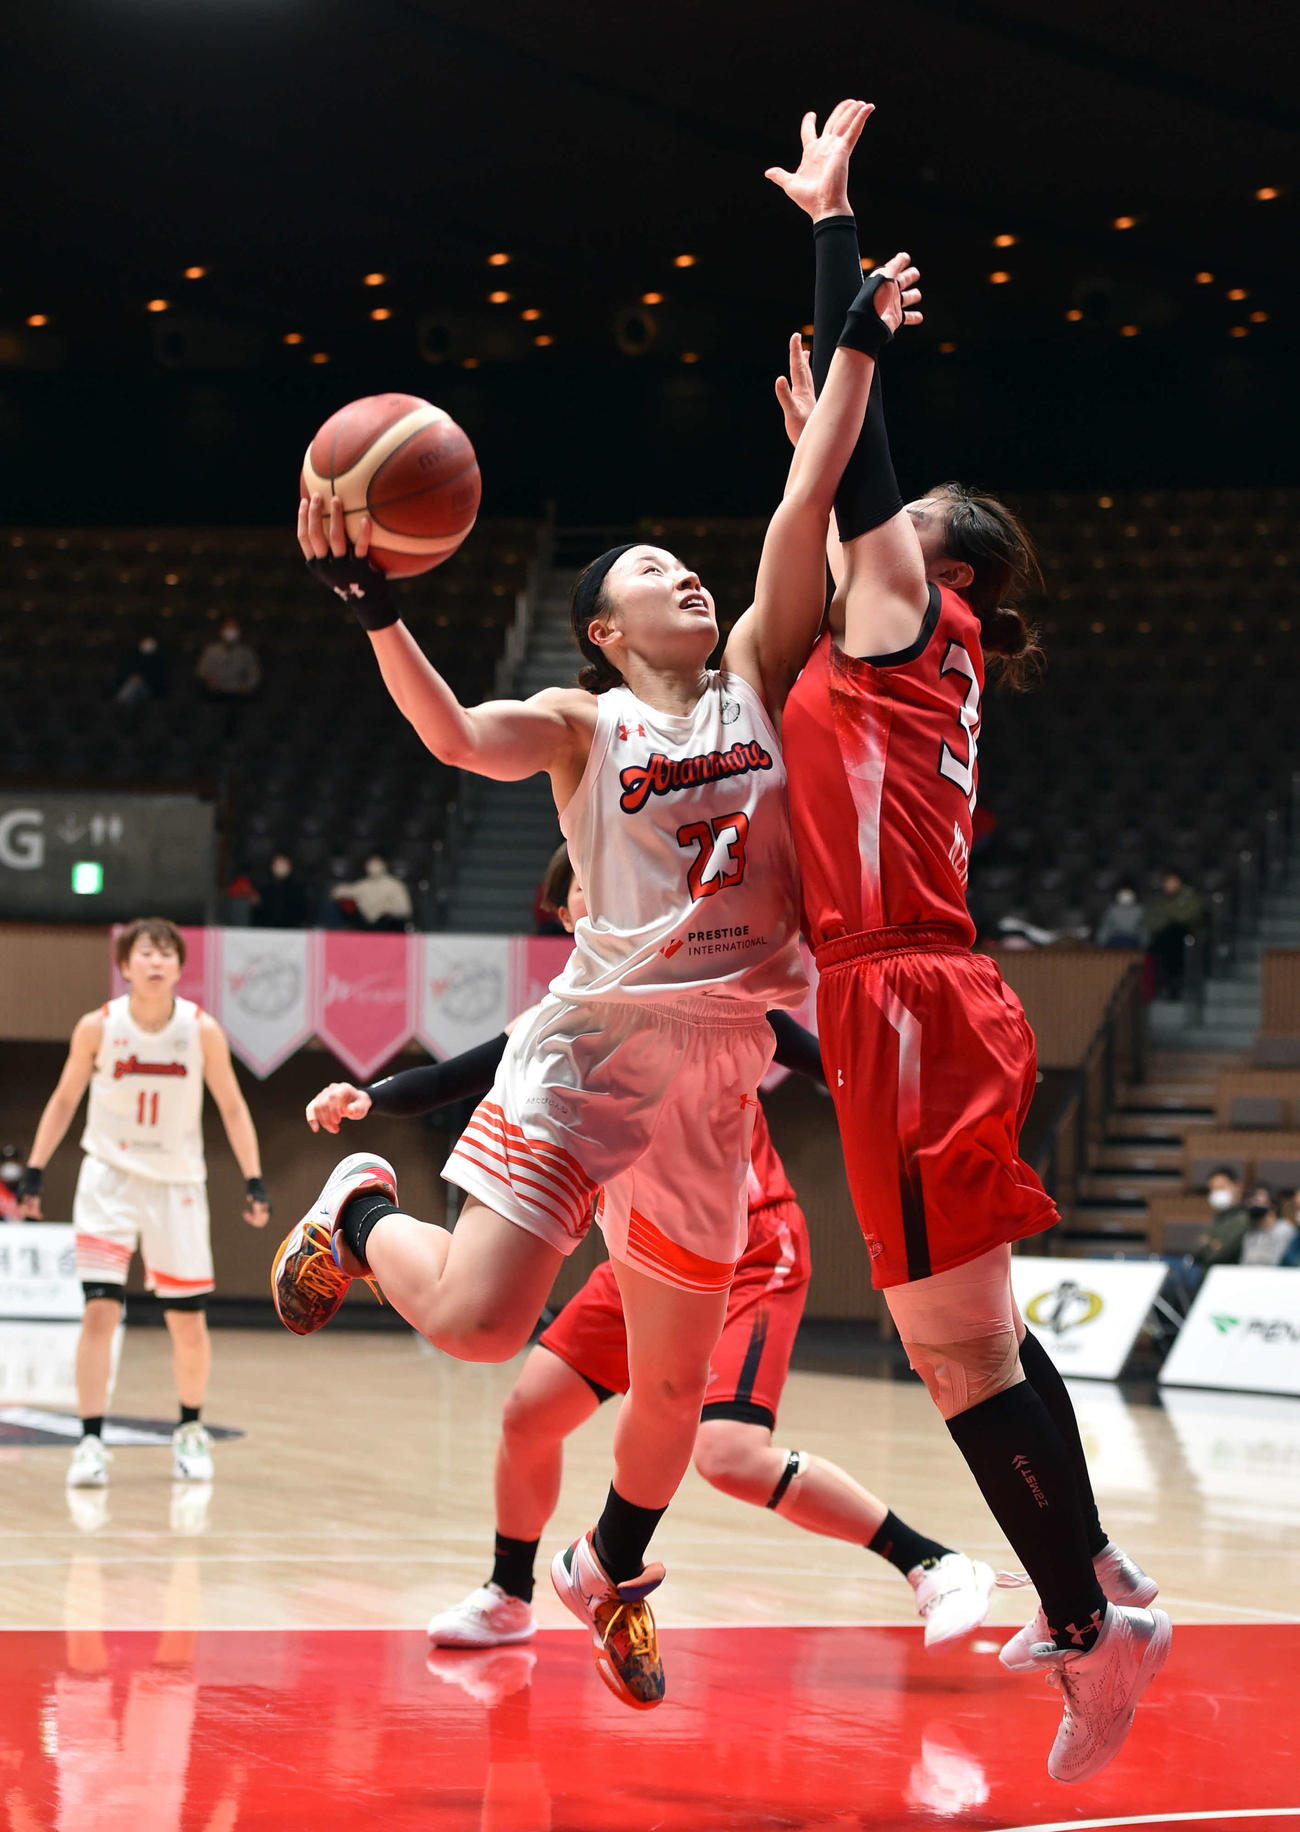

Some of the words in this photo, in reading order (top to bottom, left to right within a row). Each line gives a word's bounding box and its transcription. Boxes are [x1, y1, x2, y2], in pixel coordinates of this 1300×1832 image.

[619, 739, 774, 814] Aranmare
[676, 810, 751, 903] 23
[687, 925, 750, 943] PRESTIGE
[687, 936, 769, 957] INTERNATIONAL
[137, 1090, 159, 1126] 11
